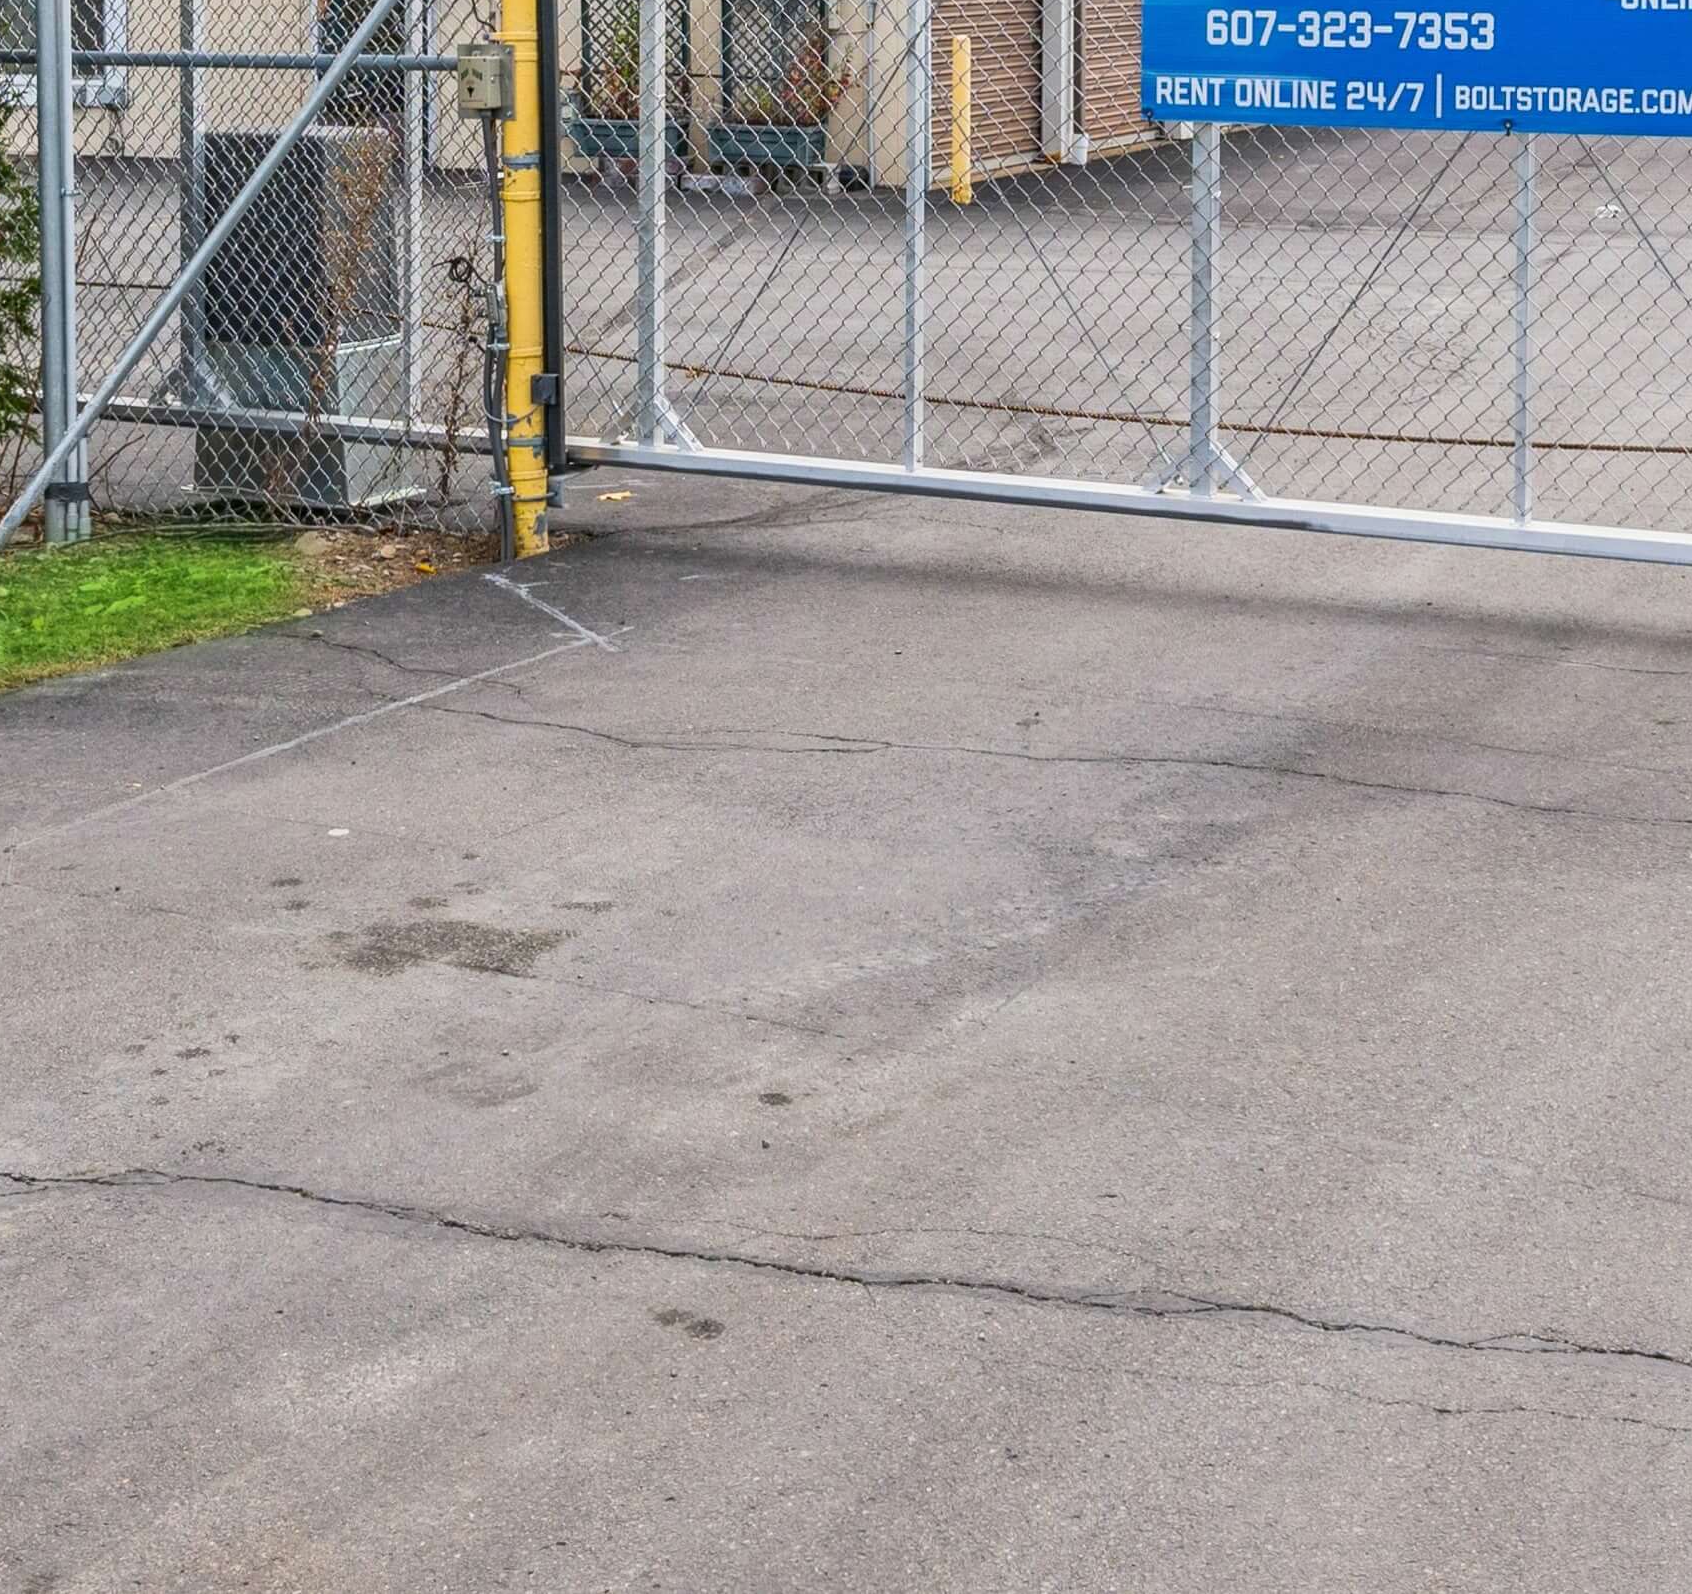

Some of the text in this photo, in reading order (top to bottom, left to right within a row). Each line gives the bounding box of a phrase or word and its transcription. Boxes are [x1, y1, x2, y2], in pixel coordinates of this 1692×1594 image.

[1206, 9, 1495, 50] 607-323-7353
[1156, 76, 1425, 112] RENT ONLINE 24/7
